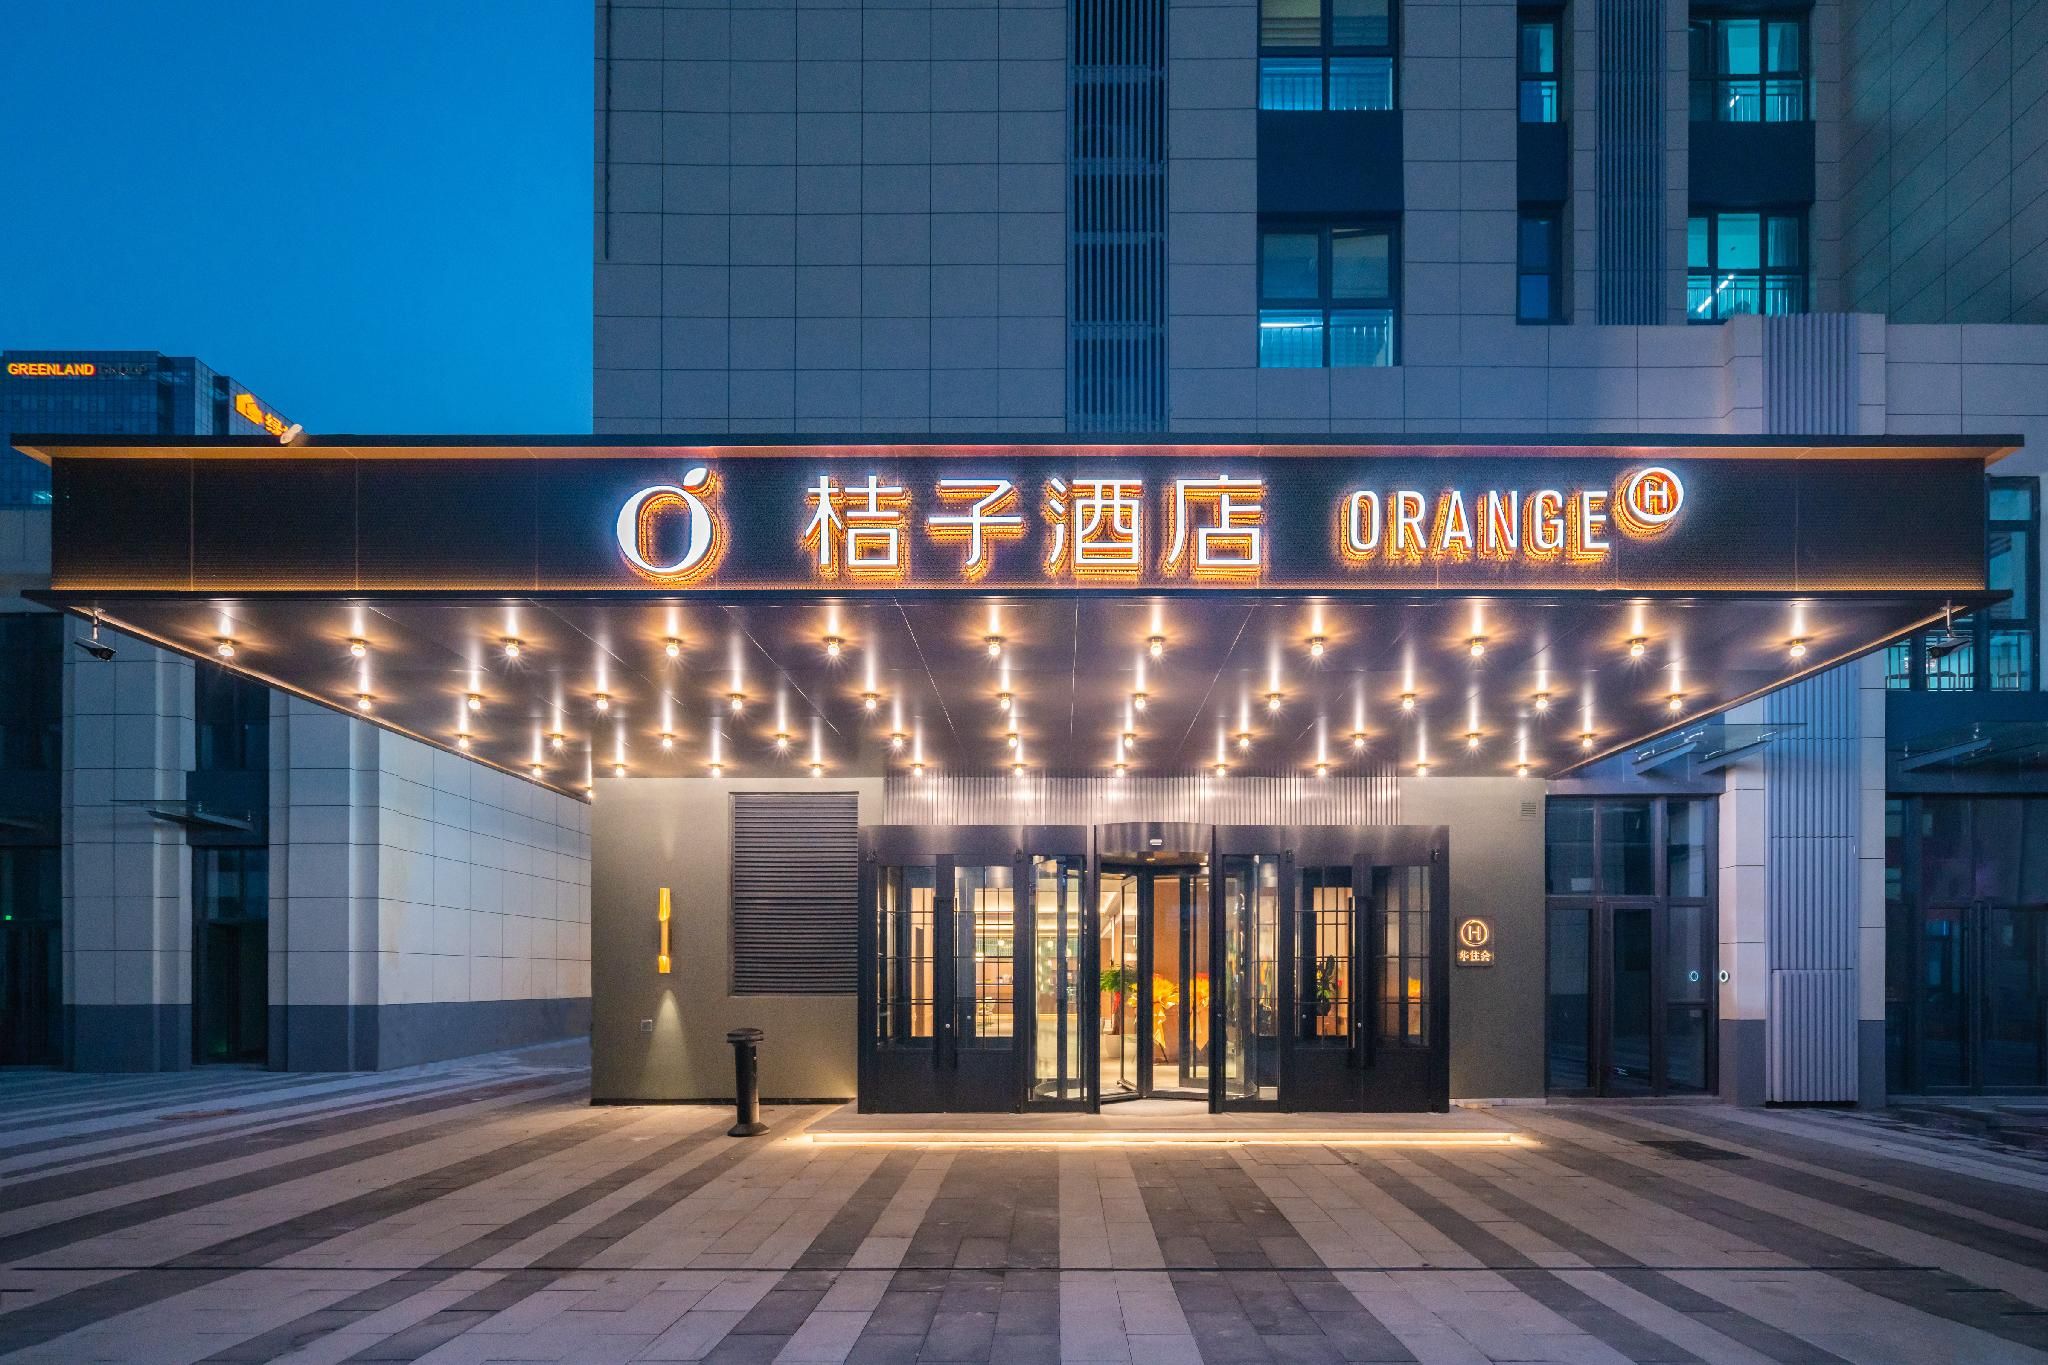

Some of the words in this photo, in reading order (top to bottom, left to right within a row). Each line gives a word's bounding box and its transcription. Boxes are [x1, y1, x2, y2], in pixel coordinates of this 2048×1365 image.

[7, 363, 95, 376] GREENLAND
[804, 475, 1262, 567] 桔子酒店
[1350, 489, 1610, 549] ORANGE
[1459, 950, 1491, 962] 华住会
